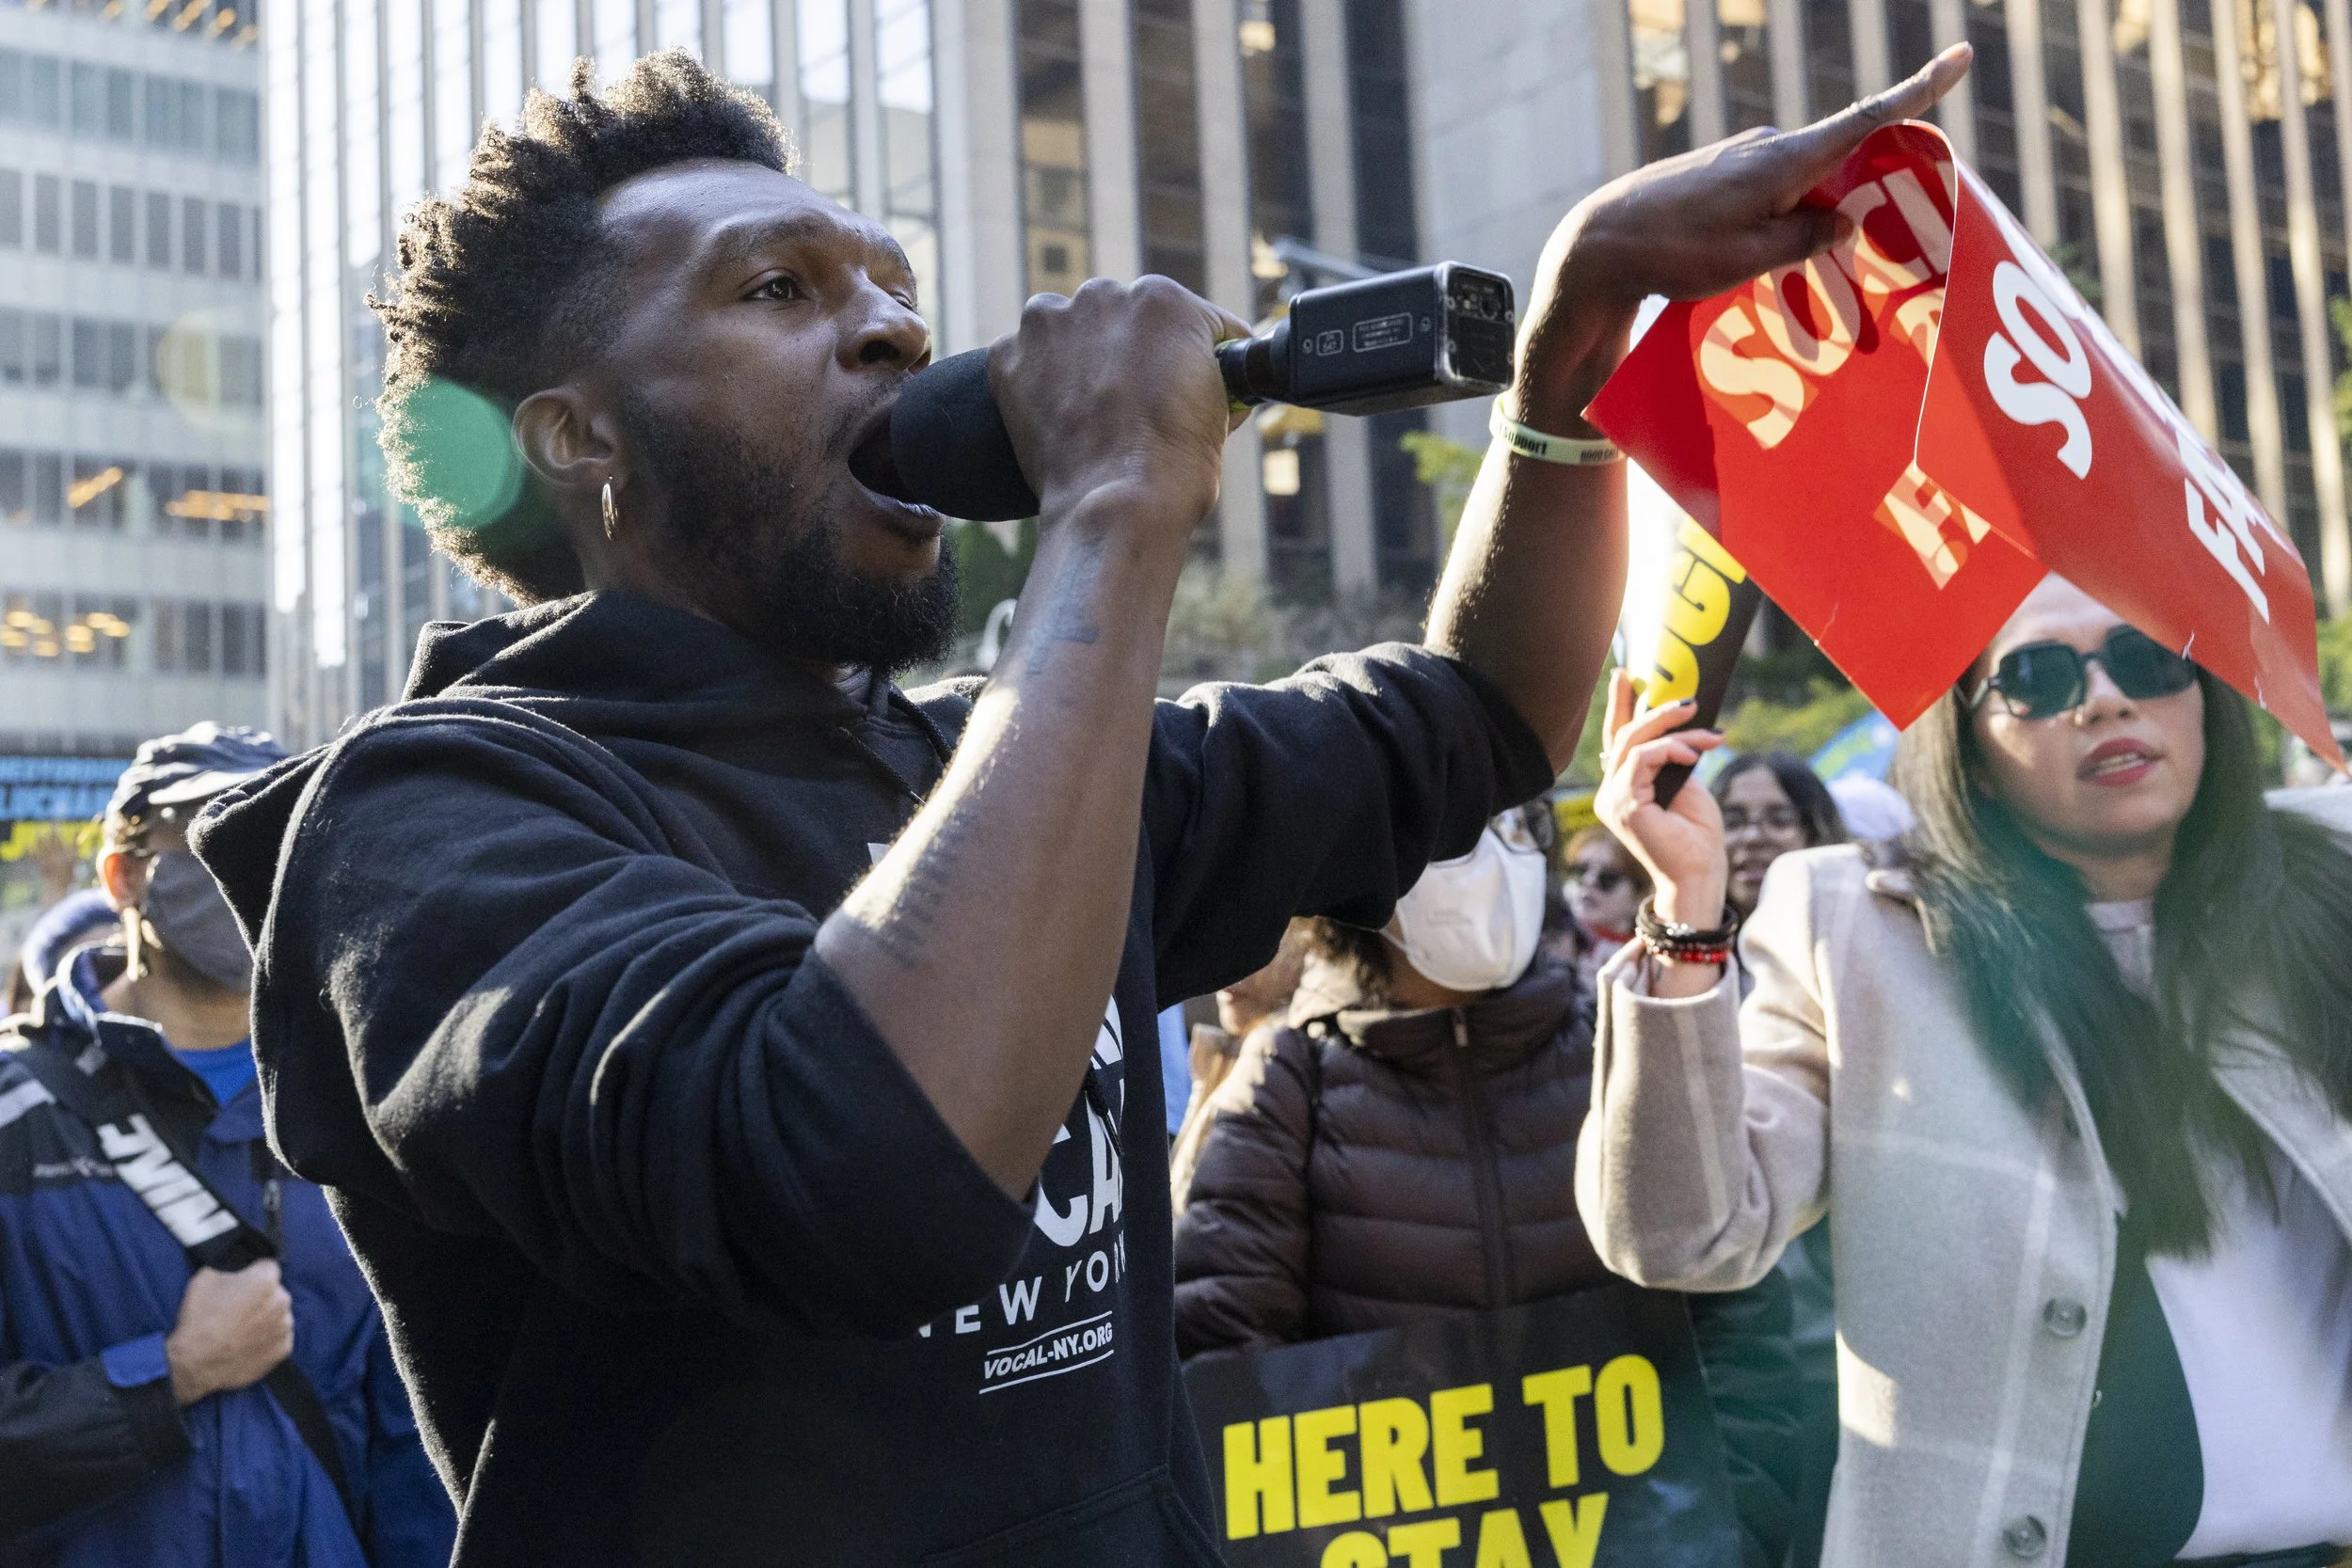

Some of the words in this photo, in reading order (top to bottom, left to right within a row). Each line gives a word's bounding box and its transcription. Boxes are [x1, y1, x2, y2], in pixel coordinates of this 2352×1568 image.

[1699, 161, 1957, 451] SOCI
[918, 1275, 1042, 1338] EW
[983, 1322, 1114, 1380] VOCAL-NY.ORG
[1223, 1384, 1500, 1541] HERE
[1522, 1354, 1665, 1489] TO
